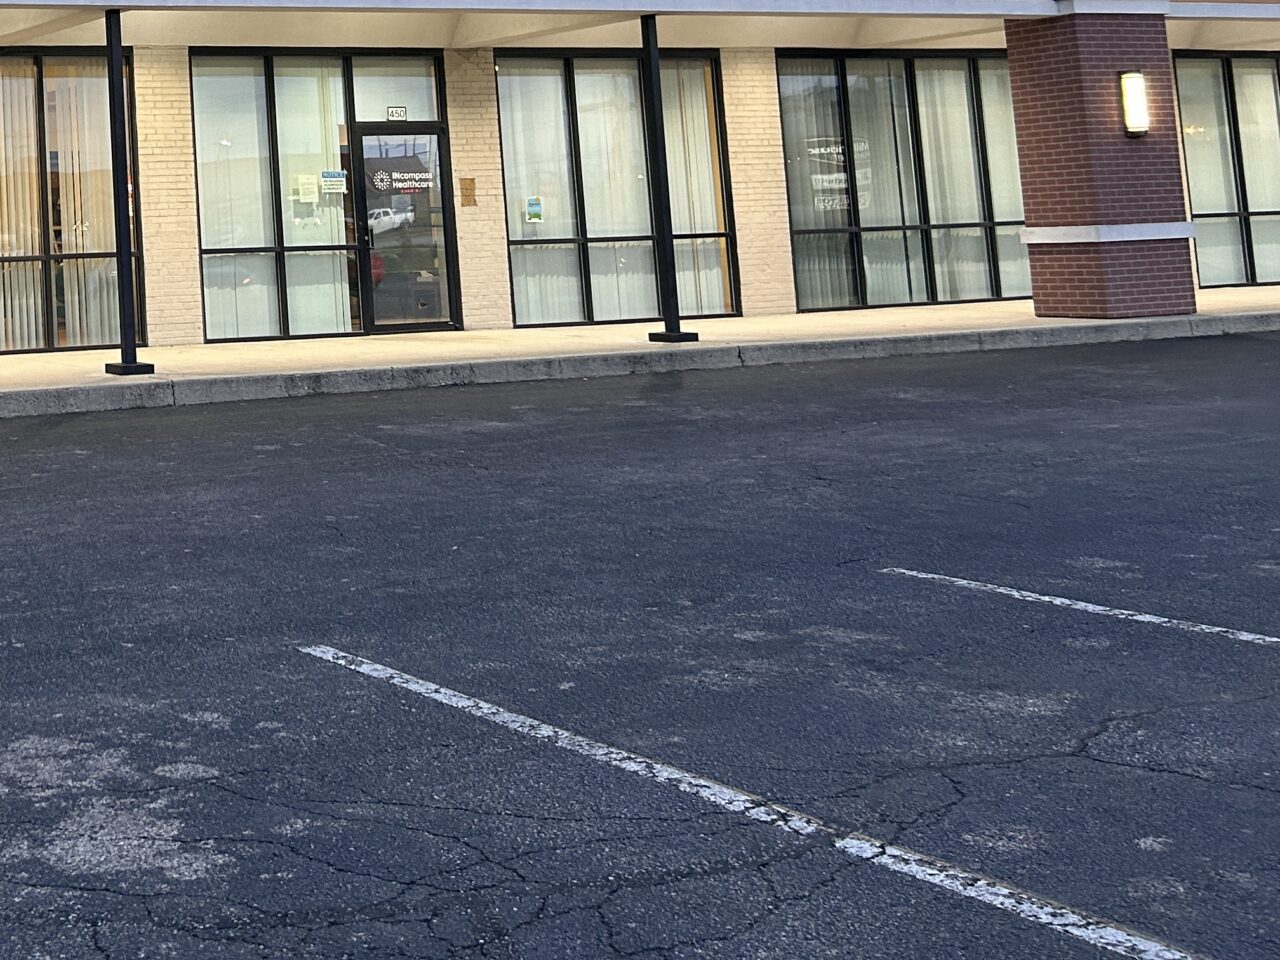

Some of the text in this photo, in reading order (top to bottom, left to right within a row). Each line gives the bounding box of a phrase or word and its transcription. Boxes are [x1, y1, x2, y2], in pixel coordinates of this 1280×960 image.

[389, 109, 405, 119] 450
[391, 171, 433, 180] INcompass
[392, 180, 434, 189] Healthcare
